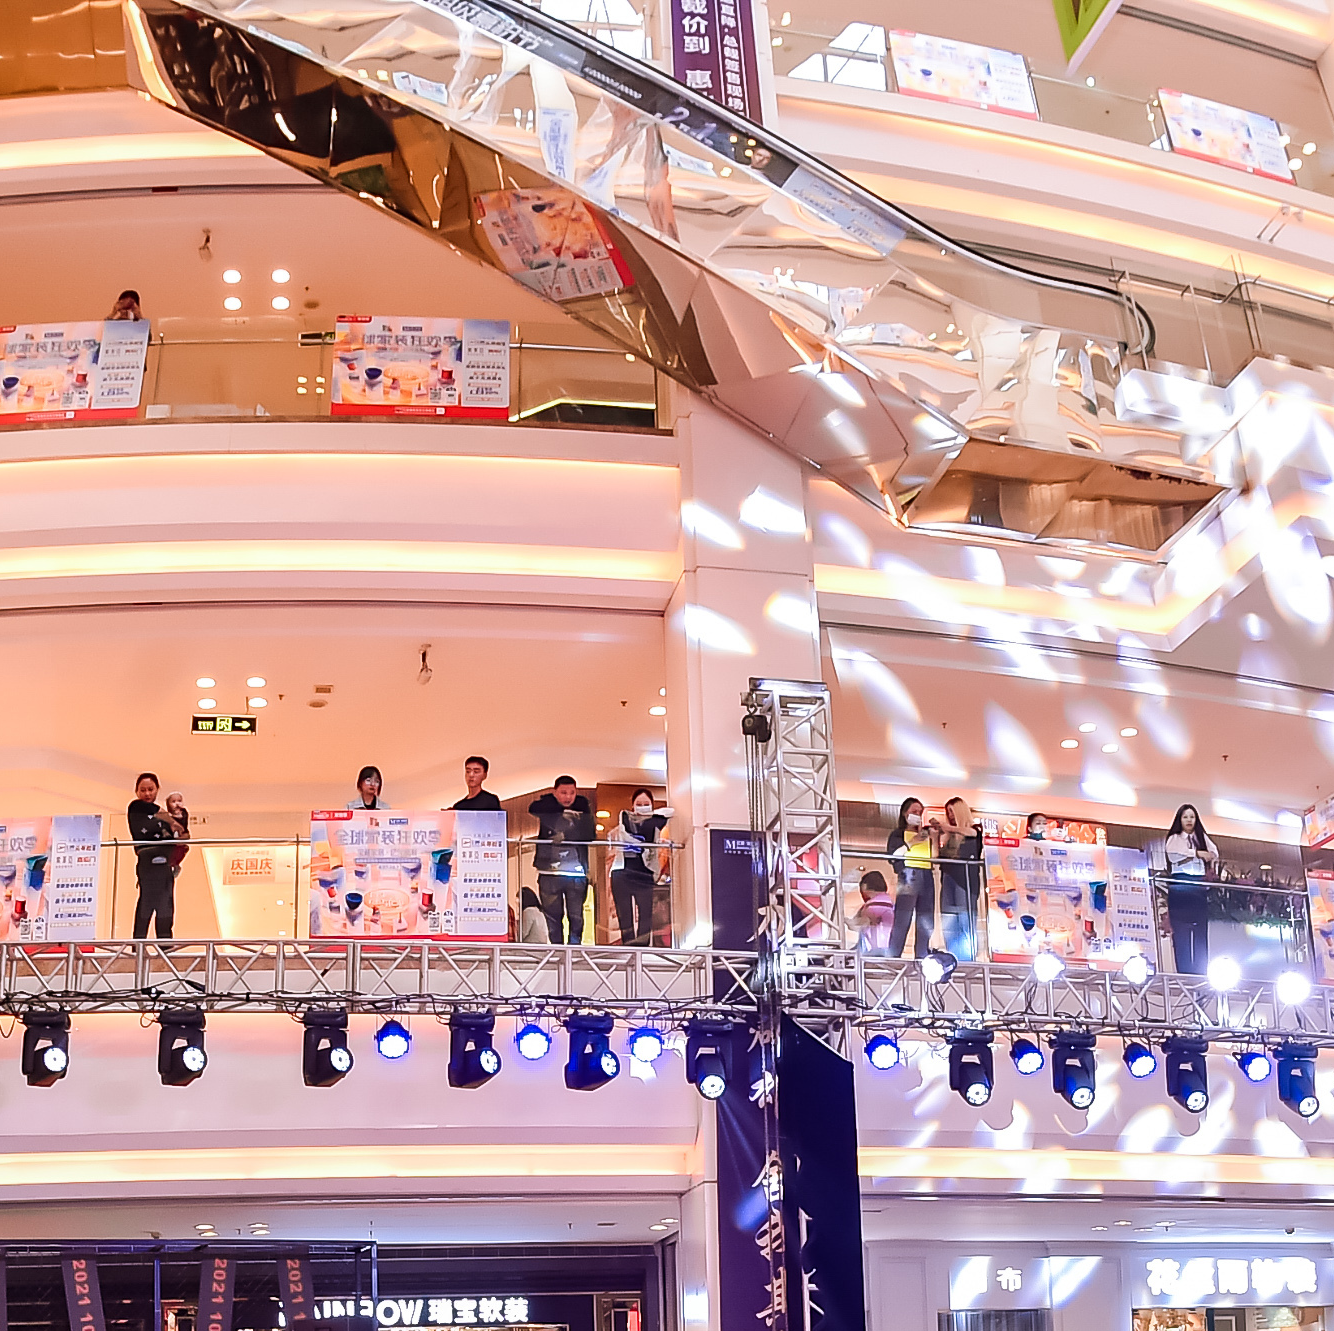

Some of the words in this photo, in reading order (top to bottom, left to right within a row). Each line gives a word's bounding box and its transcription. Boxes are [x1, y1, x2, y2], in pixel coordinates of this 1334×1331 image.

[684, 69, 714, 99] 惠
[230, 857, 273, 872] 庆国庆
[72, 1259, 91, 1306] 2021
[211, 1258, 228, 1304] 2021
[286, 1258, 305, 1304] 2021
[428, 1296, 529, 1325] 瑞宝软装
